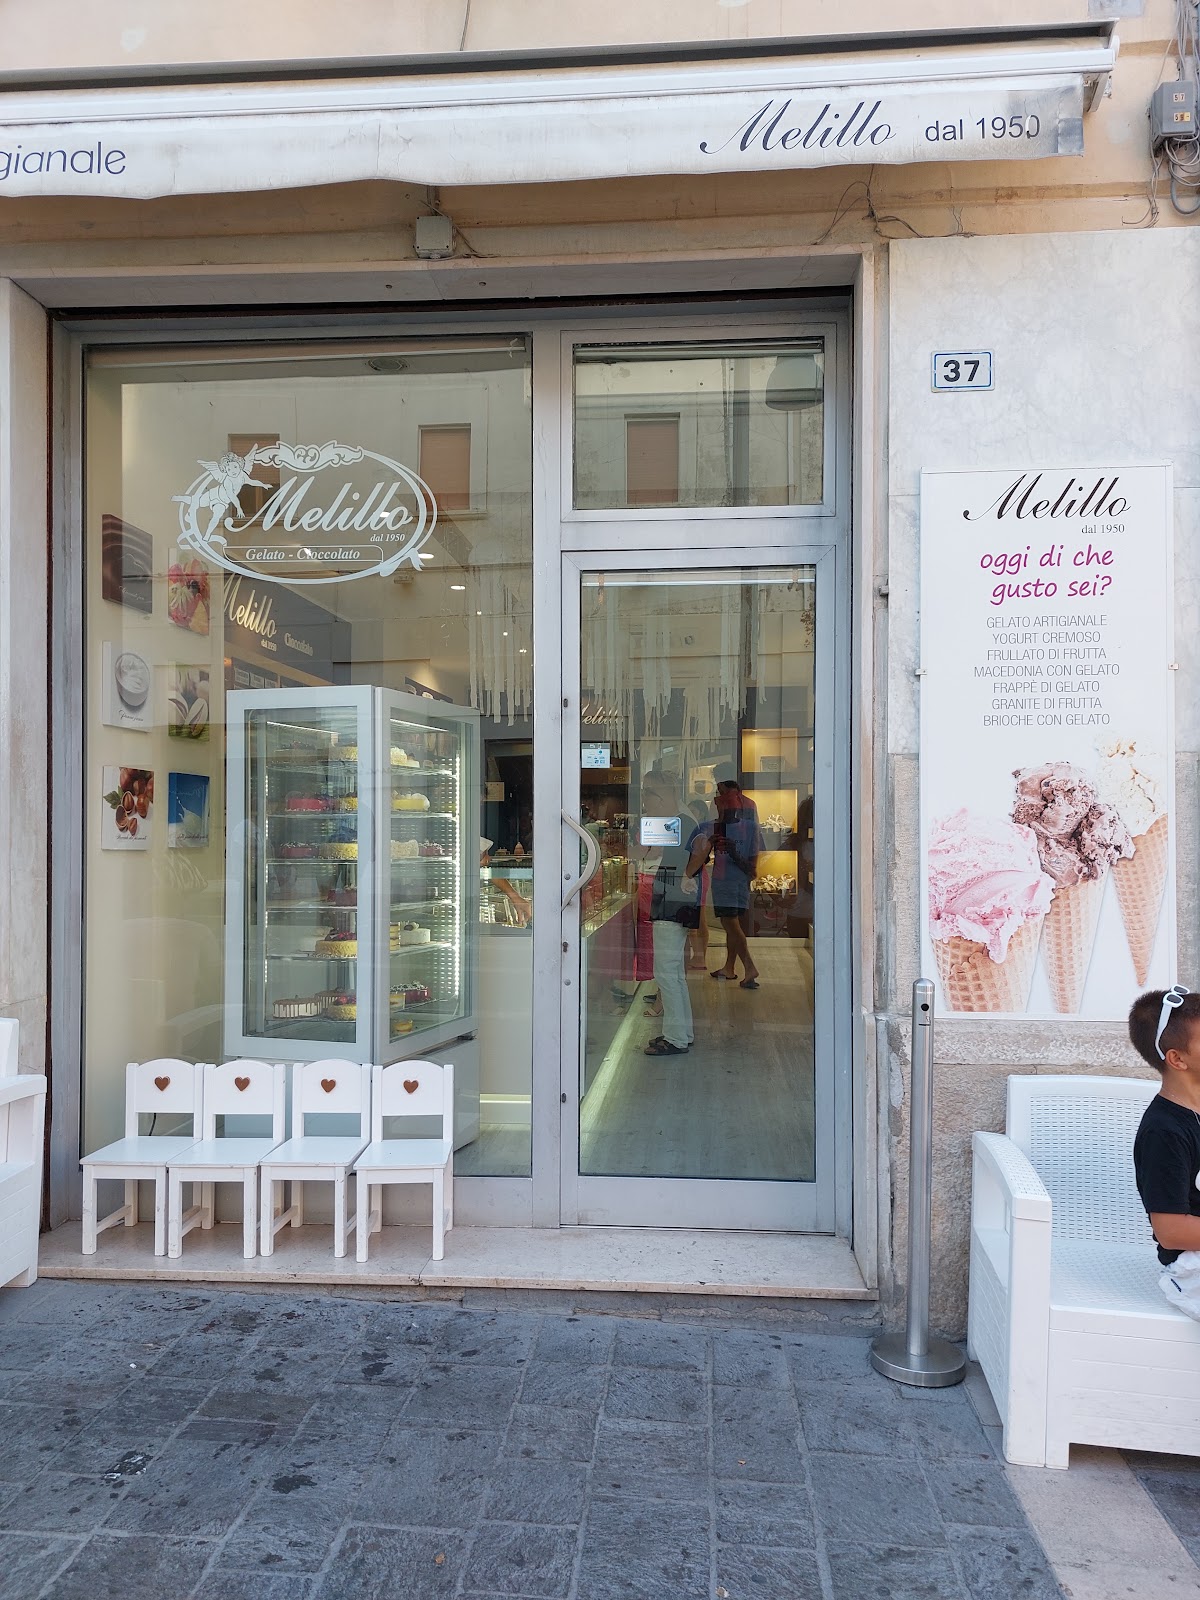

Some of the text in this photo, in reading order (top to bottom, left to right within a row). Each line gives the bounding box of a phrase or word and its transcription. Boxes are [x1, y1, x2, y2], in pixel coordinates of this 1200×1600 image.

[699, 98, 1041, 155] Melillo dal 1950
[943, 360, 980, 382] 37
[963, 472, 1132, 520] Melillo
[224, 476, 413, 532] Melillo
[1082, 524, 1125, 533] dal 1950
[370, 533, 405, 542] dal 1950
[246, 549, 285, 560] Gelato
[980, 543, 1114, 575] oggi di che
[990, 574, 1112, 605] gusto sei?
[986, 615, 1107, 628] GELATO ARTIGIANALE
[993, 631, 1101, 644] YOGURT CREMOSO
[987, 648, 1106, 661] FRULLATO DI FRUTTA
[974, 664, 1119, 677] MACEDONIA CON GELATO
[1041, 682, 1051, 693] DI
[1056, 681, 1099, 692] GELATO
[992, 697, 1102, 710] GRANITE DI FRUTTA
[984, 713, 1110, 726] BRIOCHE CON GELATO
